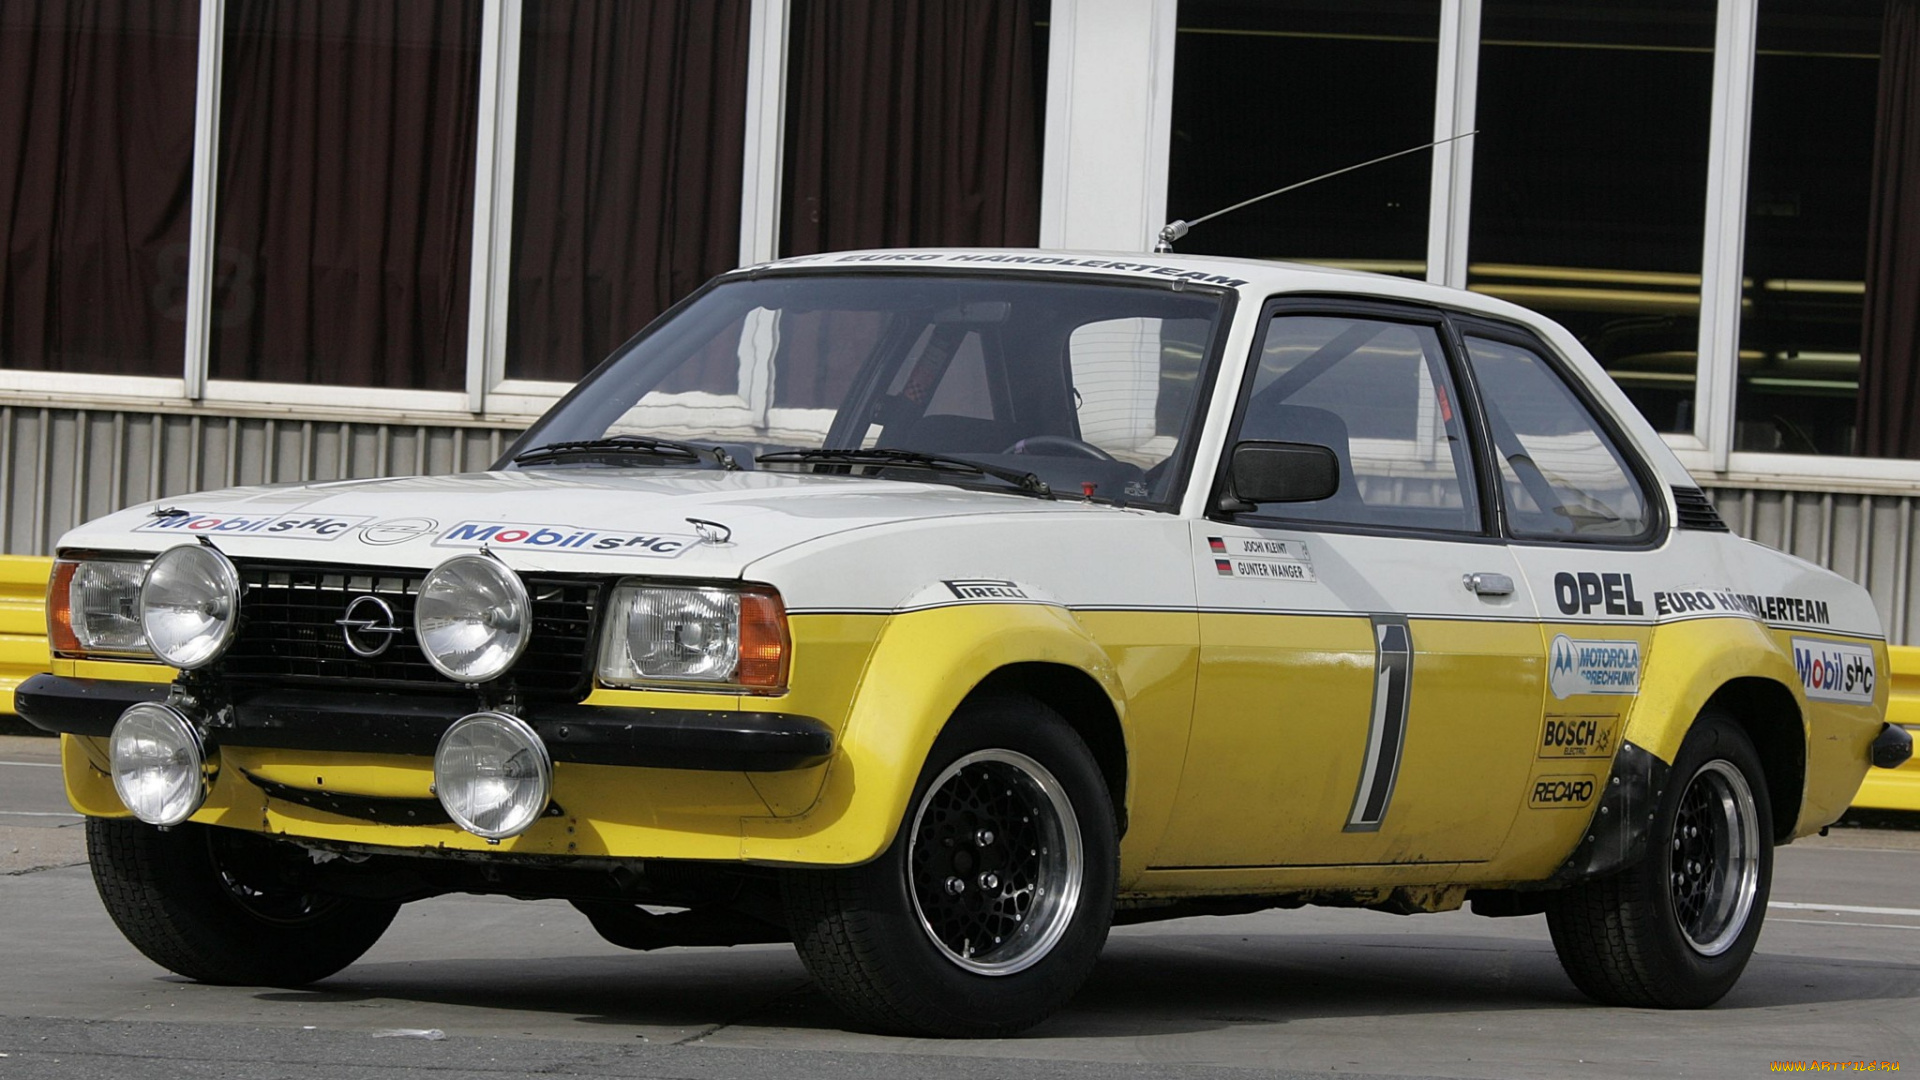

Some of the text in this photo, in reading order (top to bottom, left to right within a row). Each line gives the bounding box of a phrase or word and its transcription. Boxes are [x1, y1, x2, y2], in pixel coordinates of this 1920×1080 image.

[835, 254, 938, 263] EURO
[147, 513, 271, 532] Mobil
[446, 524, 682, 552] Mobil SHC
[1243, 540, 1264, 554] JOCHI
[1264, 541, 1287, 555] KLEINT
[1269, 564, 1305, 578] WANGER
[940, 579, 1029, 599] PIRELLI
[1554, 572, 1644, 615] OPEL
[1653, 591, 1716, 616] EURO
[1579, 647, 1638, 668] MOTOROLA
[1795, 648, 1873, 694] Mobil SHC
[1350, 624, 1410, 824] 1
[1543, 720, 1597, 747] BOSCH
[1531, 781, 1594, 803] RECARO
